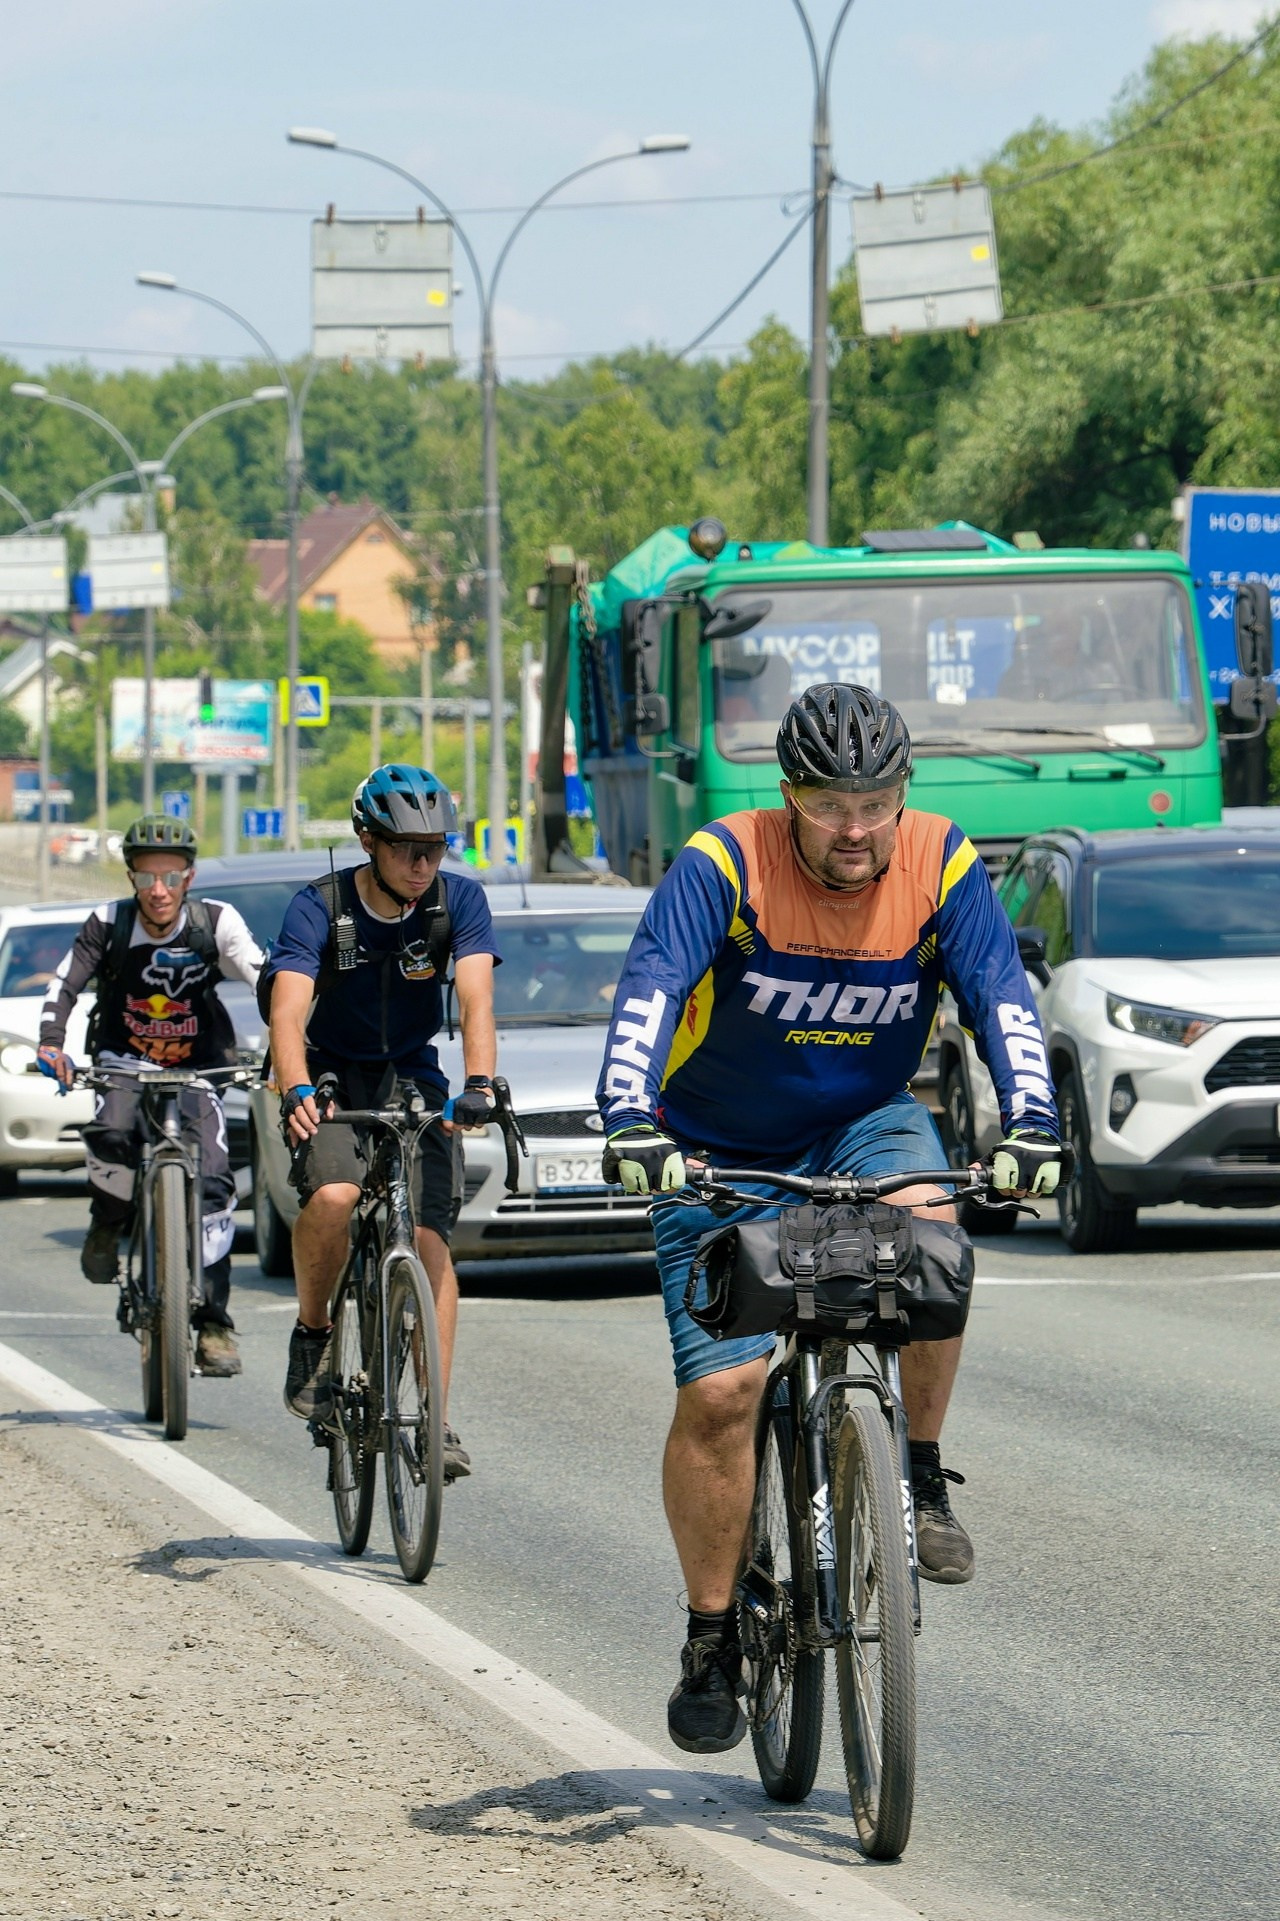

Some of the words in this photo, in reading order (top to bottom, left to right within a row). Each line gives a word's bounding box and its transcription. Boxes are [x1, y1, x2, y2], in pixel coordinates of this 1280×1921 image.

[741, 971, 919, 1024] THOR
[160, 1016, 198, 1038] Bull
[784, 1030, 874, 1045] RACING
[604, 988, 667, 1114] THOR
